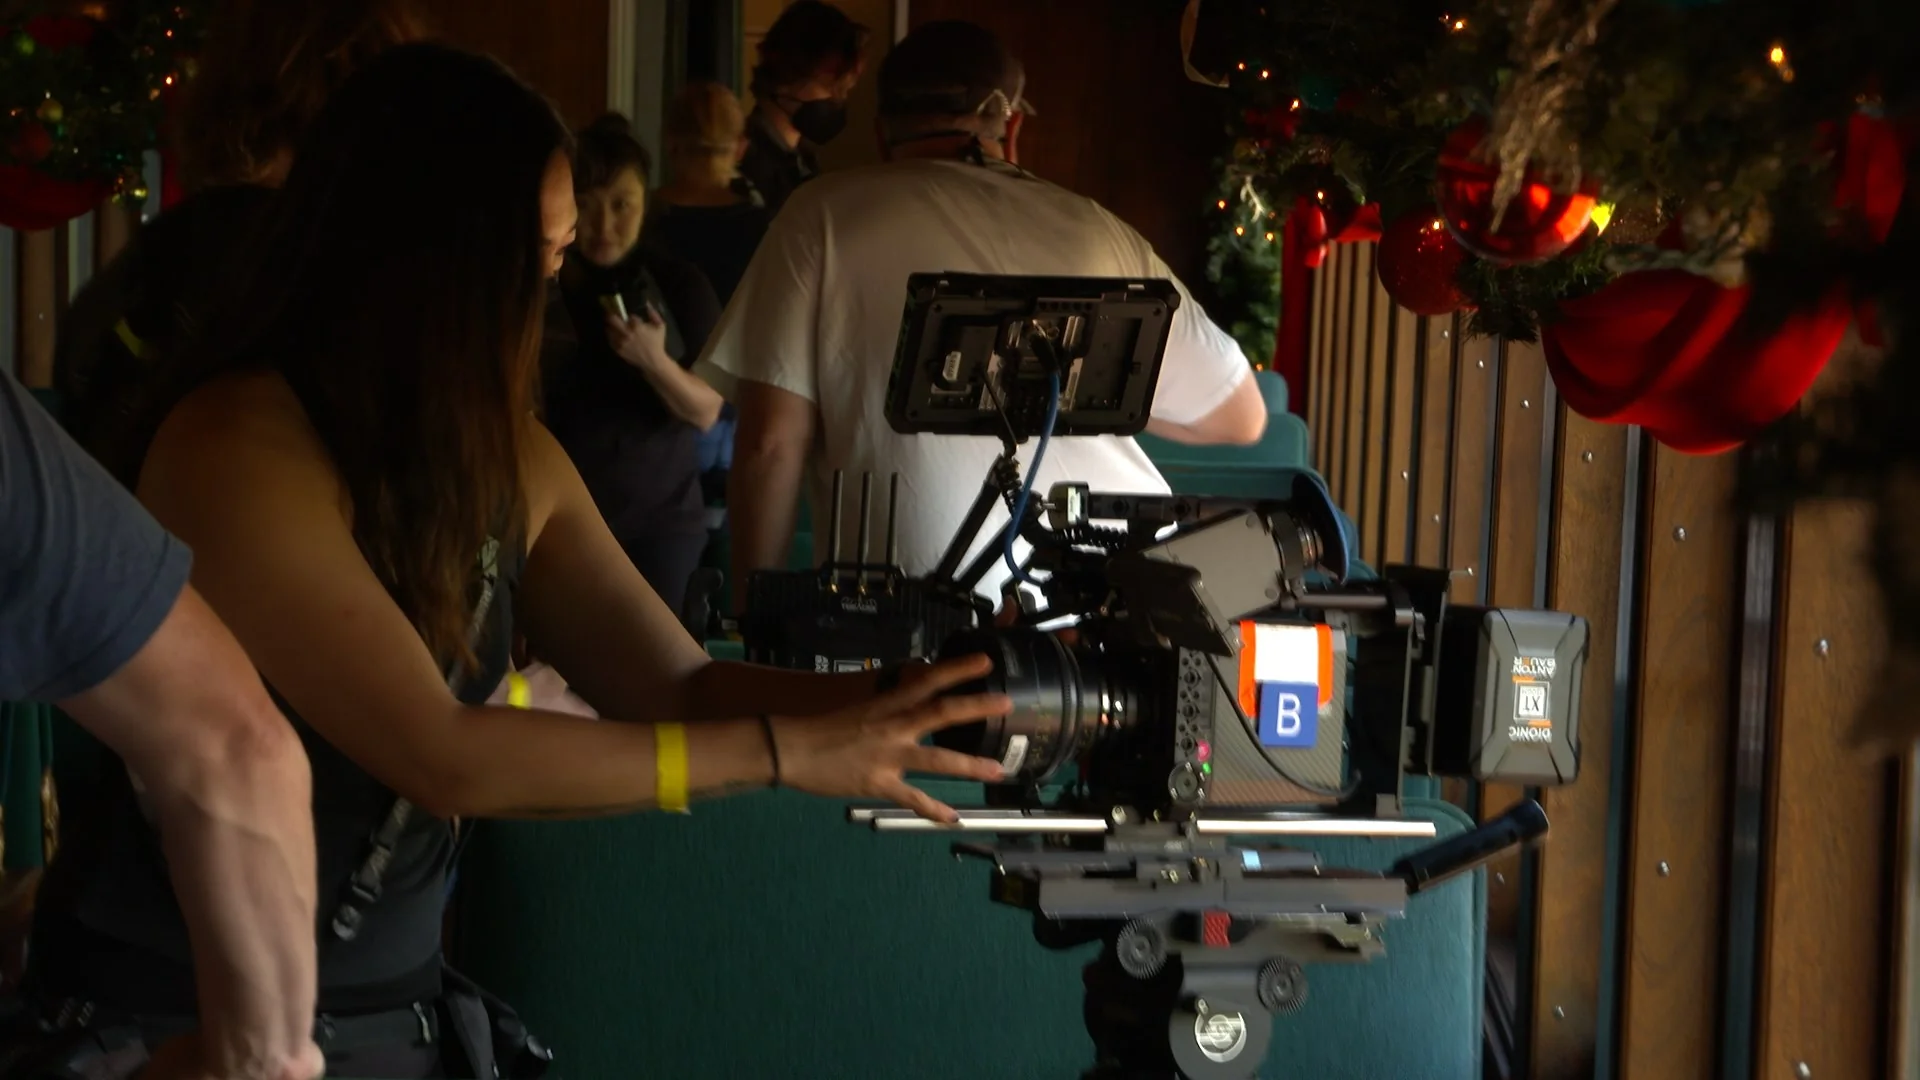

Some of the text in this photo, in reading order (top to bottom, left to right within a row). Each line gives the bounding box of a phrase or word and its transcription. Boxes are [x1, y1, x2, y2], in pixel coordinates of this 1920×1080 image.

[1513, 655, 1556, 667] BAUER
[1512, 664, 1556, 677] ANTON
[1522, 695, 1541, 712] XT
[1276, 692, 1301, 738] B
[1508, 726, 1552, 741] DIONIC
